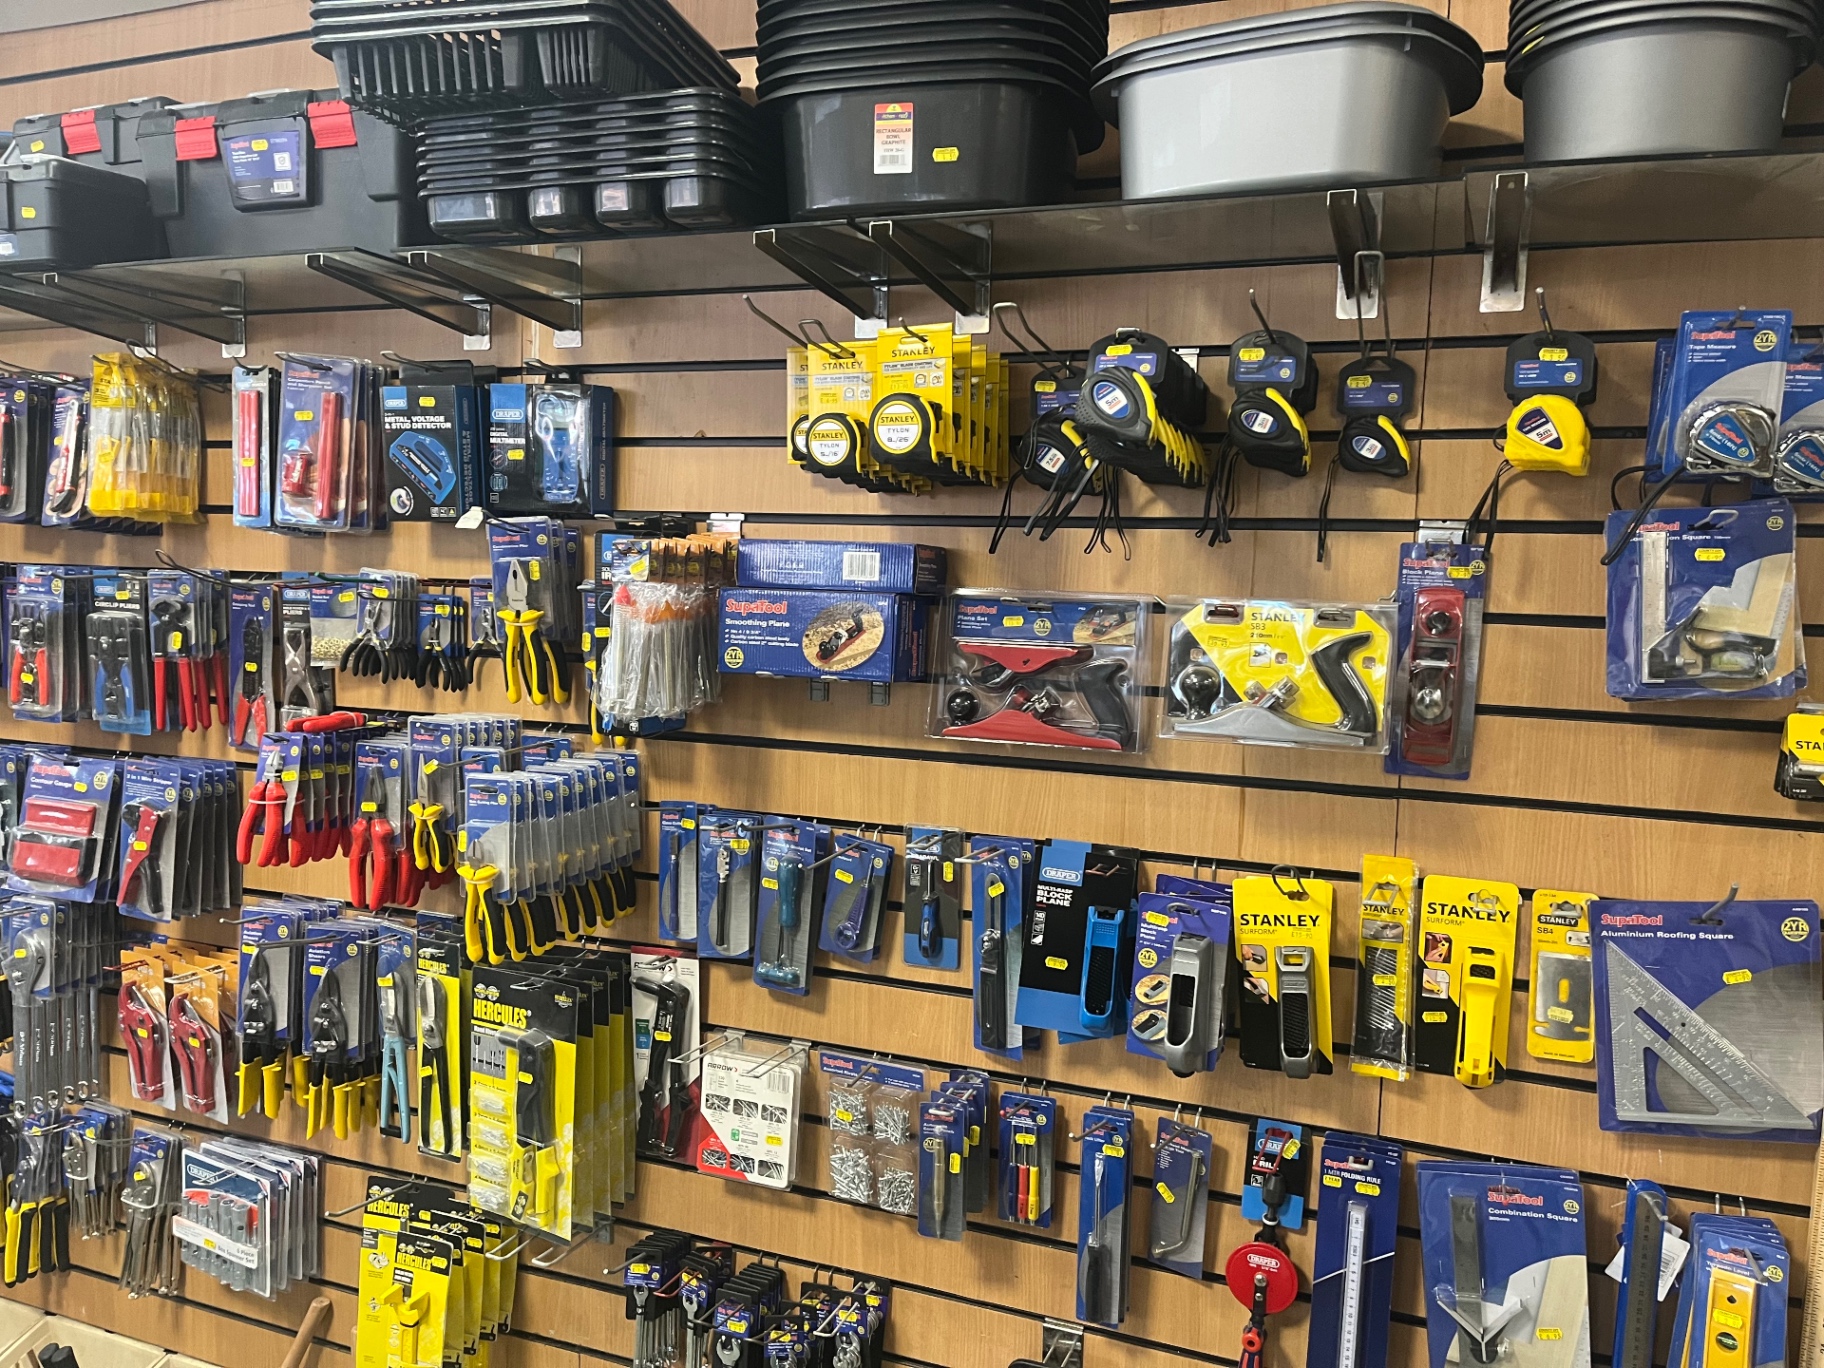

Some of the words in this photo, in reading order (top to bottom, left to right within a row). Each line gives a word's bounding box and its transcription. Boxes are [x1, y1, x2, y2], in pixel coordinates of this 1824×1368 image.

[892, 347, 935, 357] STANLEY
[822, 361, 863, 370] STANLEY
[494, 410, 522, 418] DRAPER
[1536, 428, 1551, 438] 5m
[726, 598, 787, 616] SupaTool
[725, 618, 767, 627] Smoothing
[1250, 623, 1266, 631] SB3
[54, 780, 72, 789] Gauge
[1044, 868, 1079, 881] DRAPER
[1036, 895, 1070, 907] PLANE
[1037, 890, 1072, 901] BLOCK
[1363, 904, 1404, 916] STANLEY
[1427, 902, 1510, 923] STANLEY
[1240, 913, 1321, 927] STANLEY
[1426, 917, 1463, 926] SURFORM
[1540, 915, 1576, 926] STANLEY
[1601, 914, 1663, 928] SupaTool
[1537, 926, 1554, 935] SB4
[1782, 921, 1808, 931] 2YR
[1601, 930, 1654, 939] Aluminium
[418, 957, 447, 973] HERCULES
[473, 998, 527, 1030] HERCULES
[708, 1062, 733, 1072] ARROW
[1341, 1171, 1366, 1181] FOLDING
[367, 1200, 410, 1218] HERCULES
[1488, 1207, 1544, 1219] Combination
[1546, 1212, 1578, 1223] Square
[396, 1251, 431, 1271] HERCULES
[1248, 1254, 1278, 1267] DRAPER
[1734, 1267, 1750, 1276] Level
